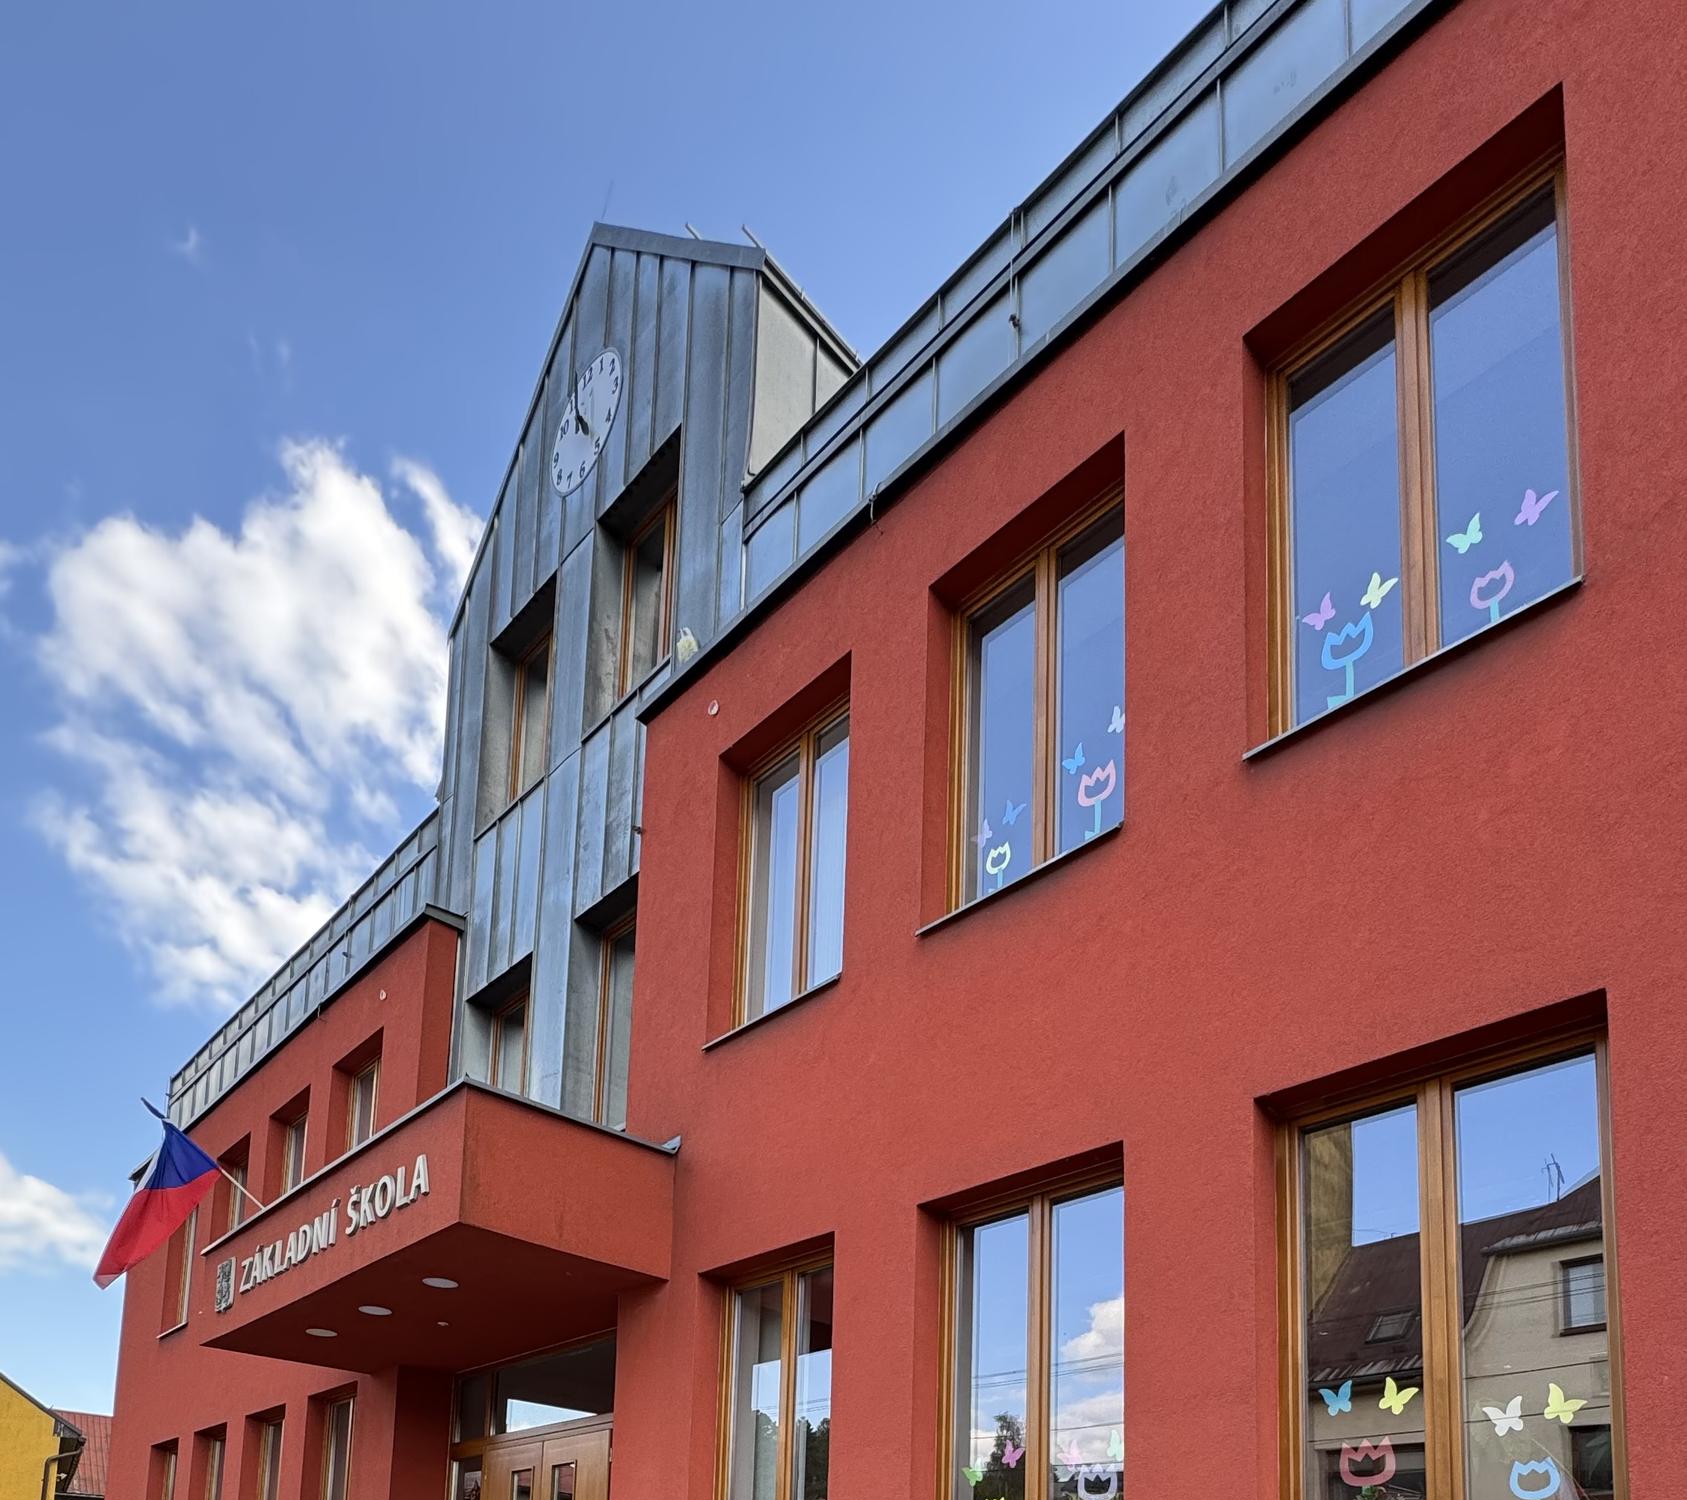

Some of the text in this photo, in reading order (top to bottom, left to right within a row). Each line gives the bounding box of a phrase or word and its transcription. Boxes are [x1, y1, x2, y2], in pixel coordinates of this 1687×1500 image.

[599, 356, 604, 375] 1
[610, 358, 615, 376] 2
[582, 366, 593, 391] 12
[612, 375, 619, 394] 3
[605, 407, 612, 423] 4
[559, 419, 570, 440] 10
[594, 436, 600, 456] 5
[553, 452, 560, 469] 9
[556, 468, 563, 486] 8
[580, 461, 586, 479] 6
[566, 471, 573, 489] 7
[239, 1154, 429, 1293] ZÁKLADNÍ ŠKOLA
